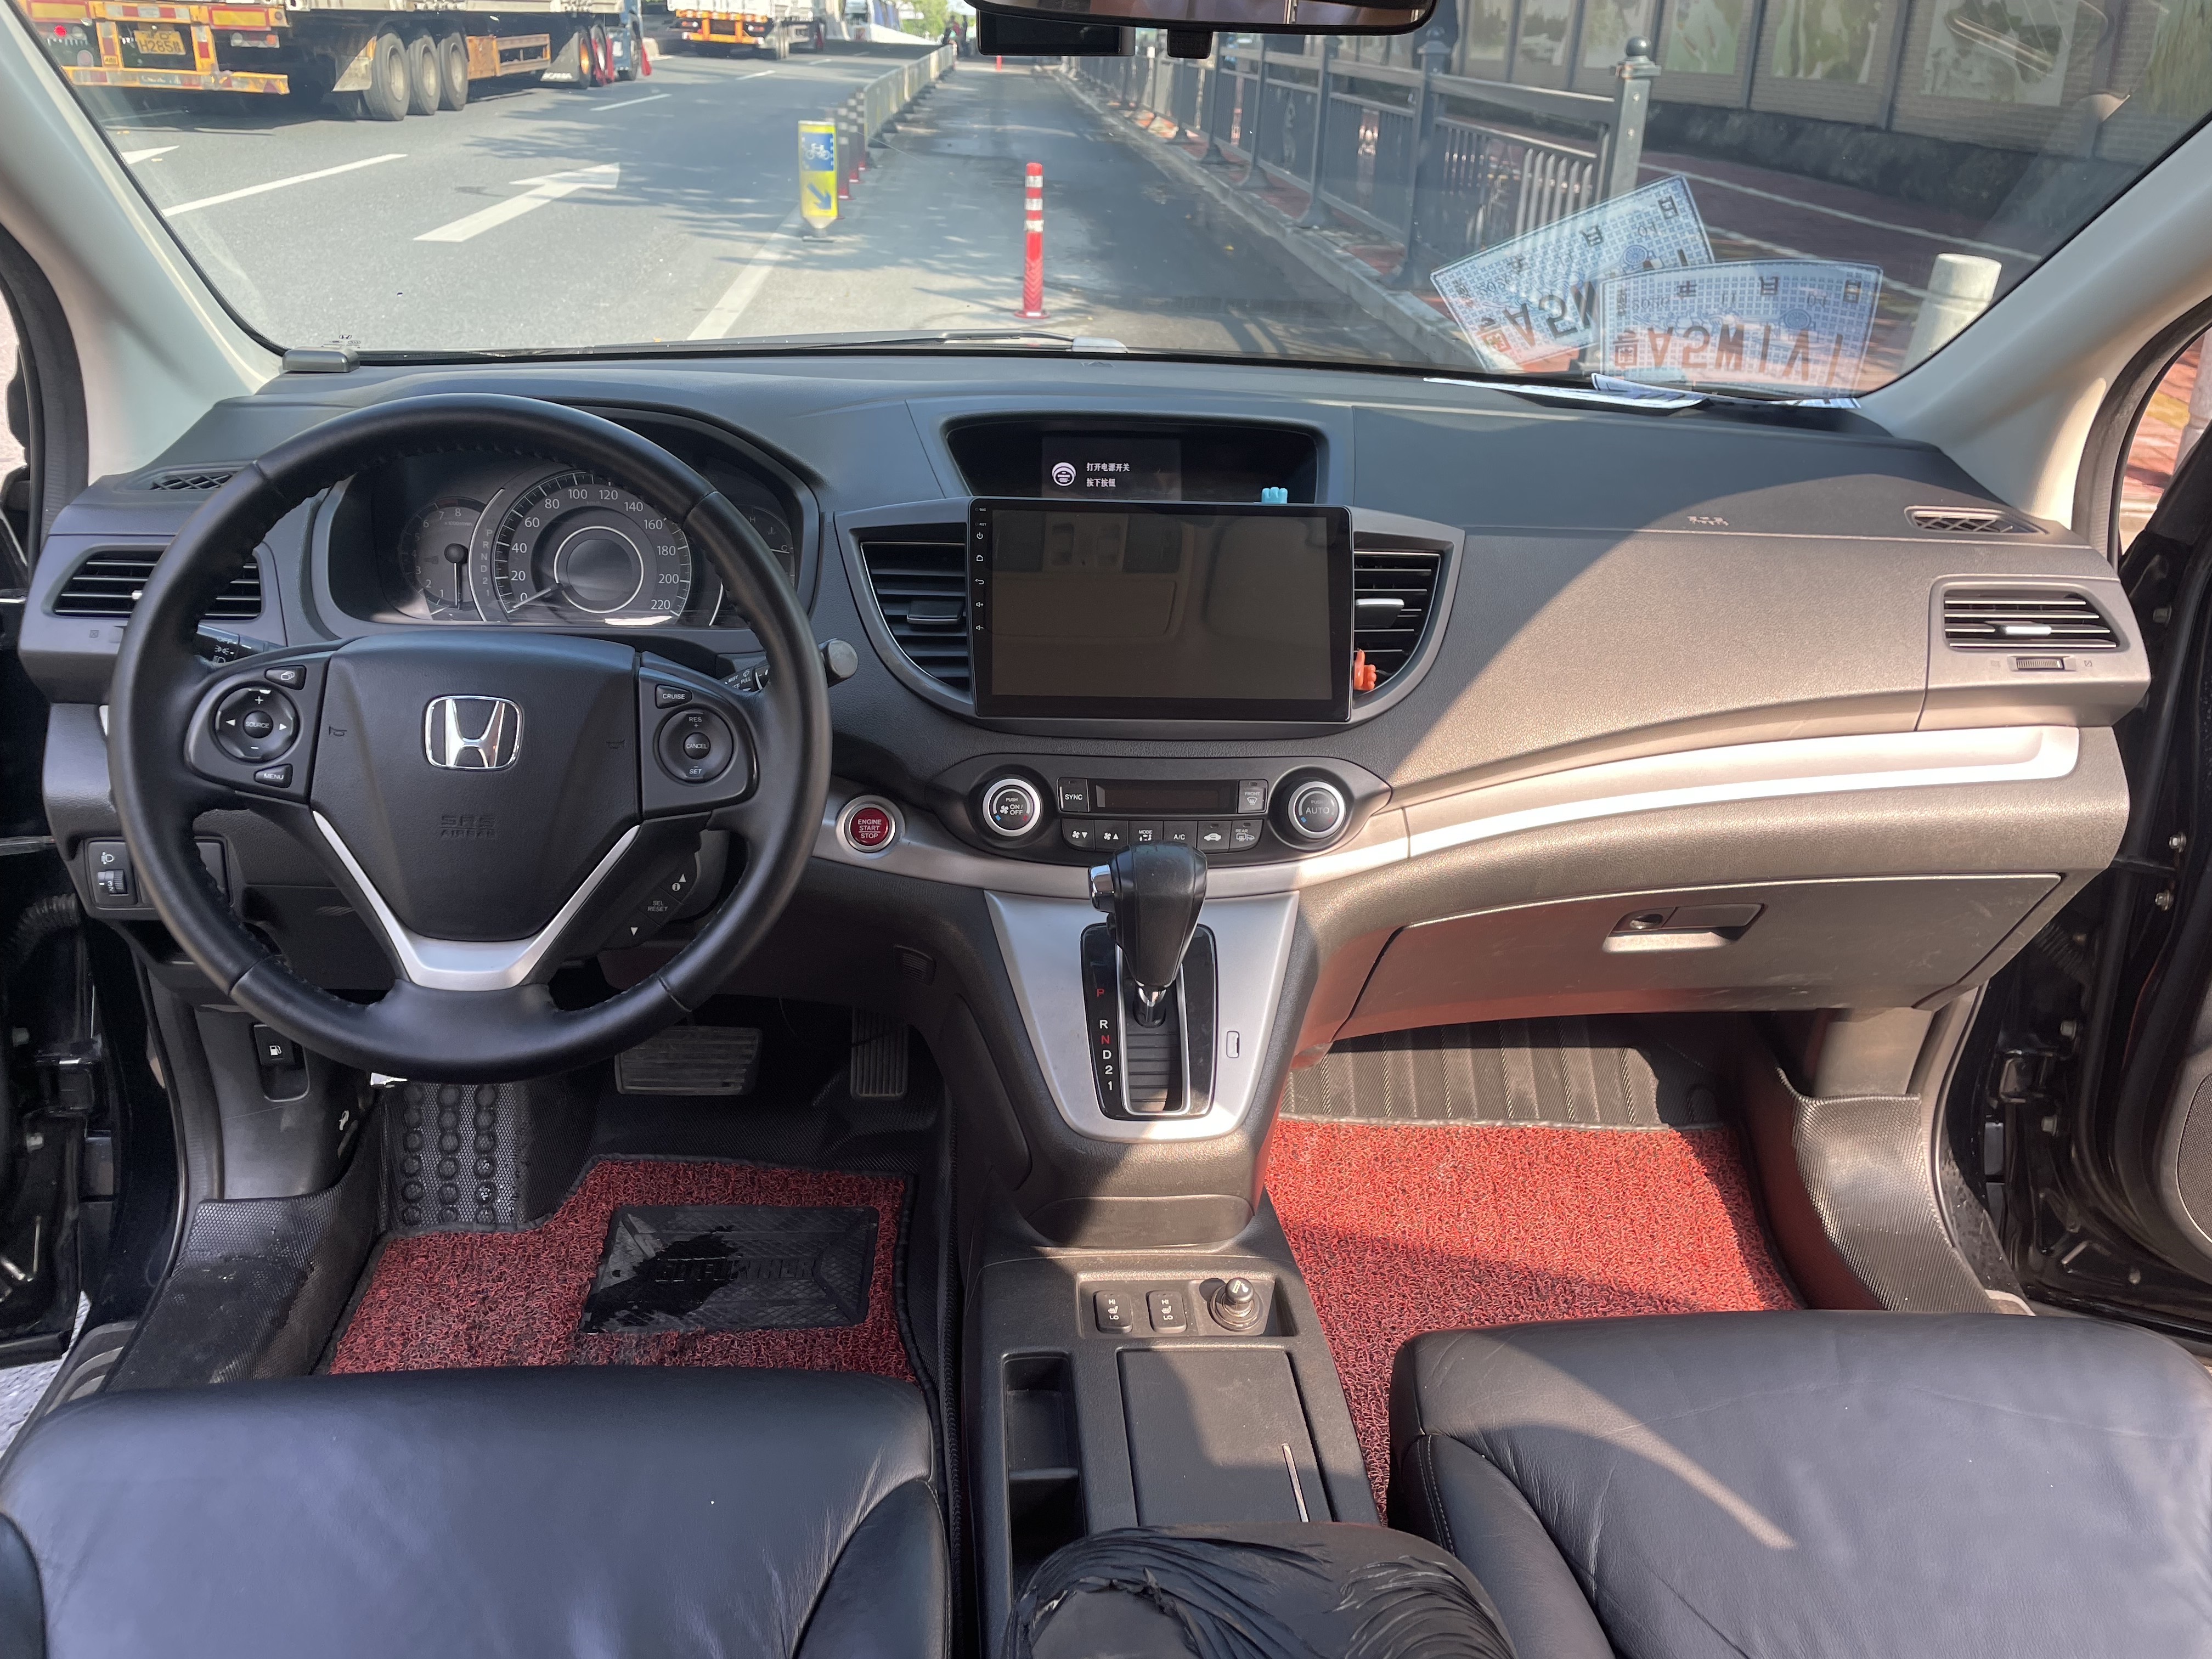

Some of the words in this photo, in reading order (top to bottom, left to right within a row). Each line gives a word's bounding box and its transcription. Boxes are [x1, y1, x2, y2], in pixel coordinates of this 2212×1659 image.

[1086, 462, 1130, 472] 打开电源开关
[1086, 478, 1116, 488] 按下按钮
[568, 489, 588, 500] 100
[599, 489, 618, 500] 120
[545, 498, 560, 509] 80
[624, 501, 644, 512] 140
[439, 511, 445, 520] 7
[454, 508, 461, 517] 8
[423, 520, 429, 528] 6
[524, 517, 540, 528] 60
[643, 519, 663, 530] 160
[414, 533, 420, 541] 5
[511, 543, 527, 554] 40
[657, 545, 676, 556] 180
[411, 550, 417, 558] 4
[415, 566, 421, 574] 3
[511, 570, 526, 581] 20
[658, 573, 679, 584] 200
[425, 579, 432, 588] 2
[439, 589, 444, 598] 1
[651, 599, 670, 610] 220
[741, 676, 751, 685] PULL
[245, 721, 269, 729] SOURCE
[1096, 988, 1105, 997] P
[1099, 1019, 1108, 1029] R
[1101, 1035, 1110, 1045] N
[1102, 1049, 1112, 1060] D
[1104, 1065, 1113, 1075] 2
[1108, 1080, 1113, 1091] 1
